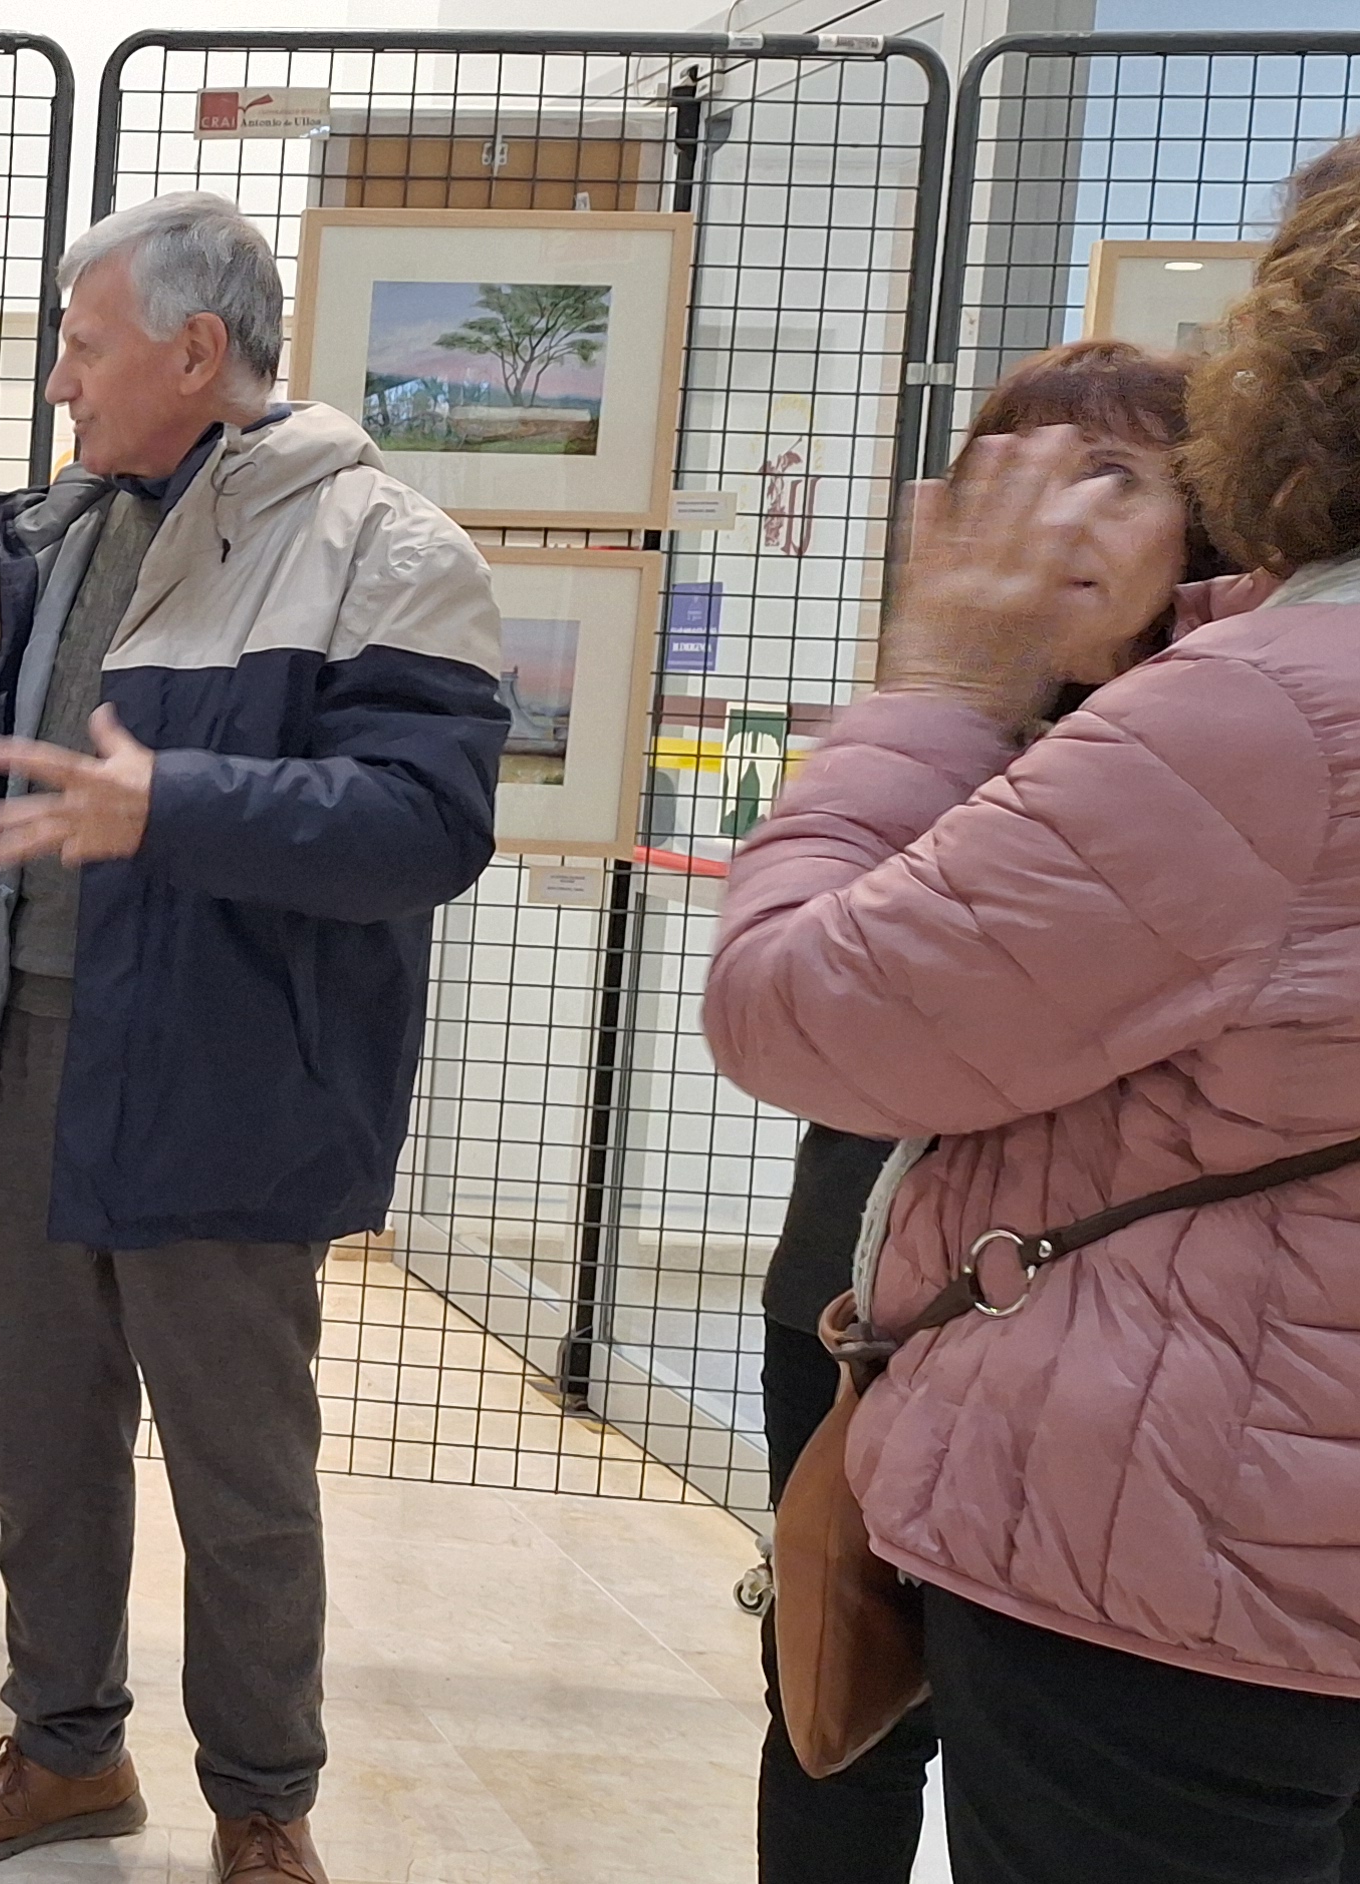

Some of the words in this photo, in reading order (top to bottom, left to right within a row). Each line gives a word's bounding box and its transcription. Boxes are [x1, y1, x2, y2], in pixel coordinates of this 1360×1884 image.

[201, 116, 236, 128] CRAI
[240, 116, 282, 128] Antonio
[294, 117, 322, 127] Ulloa
